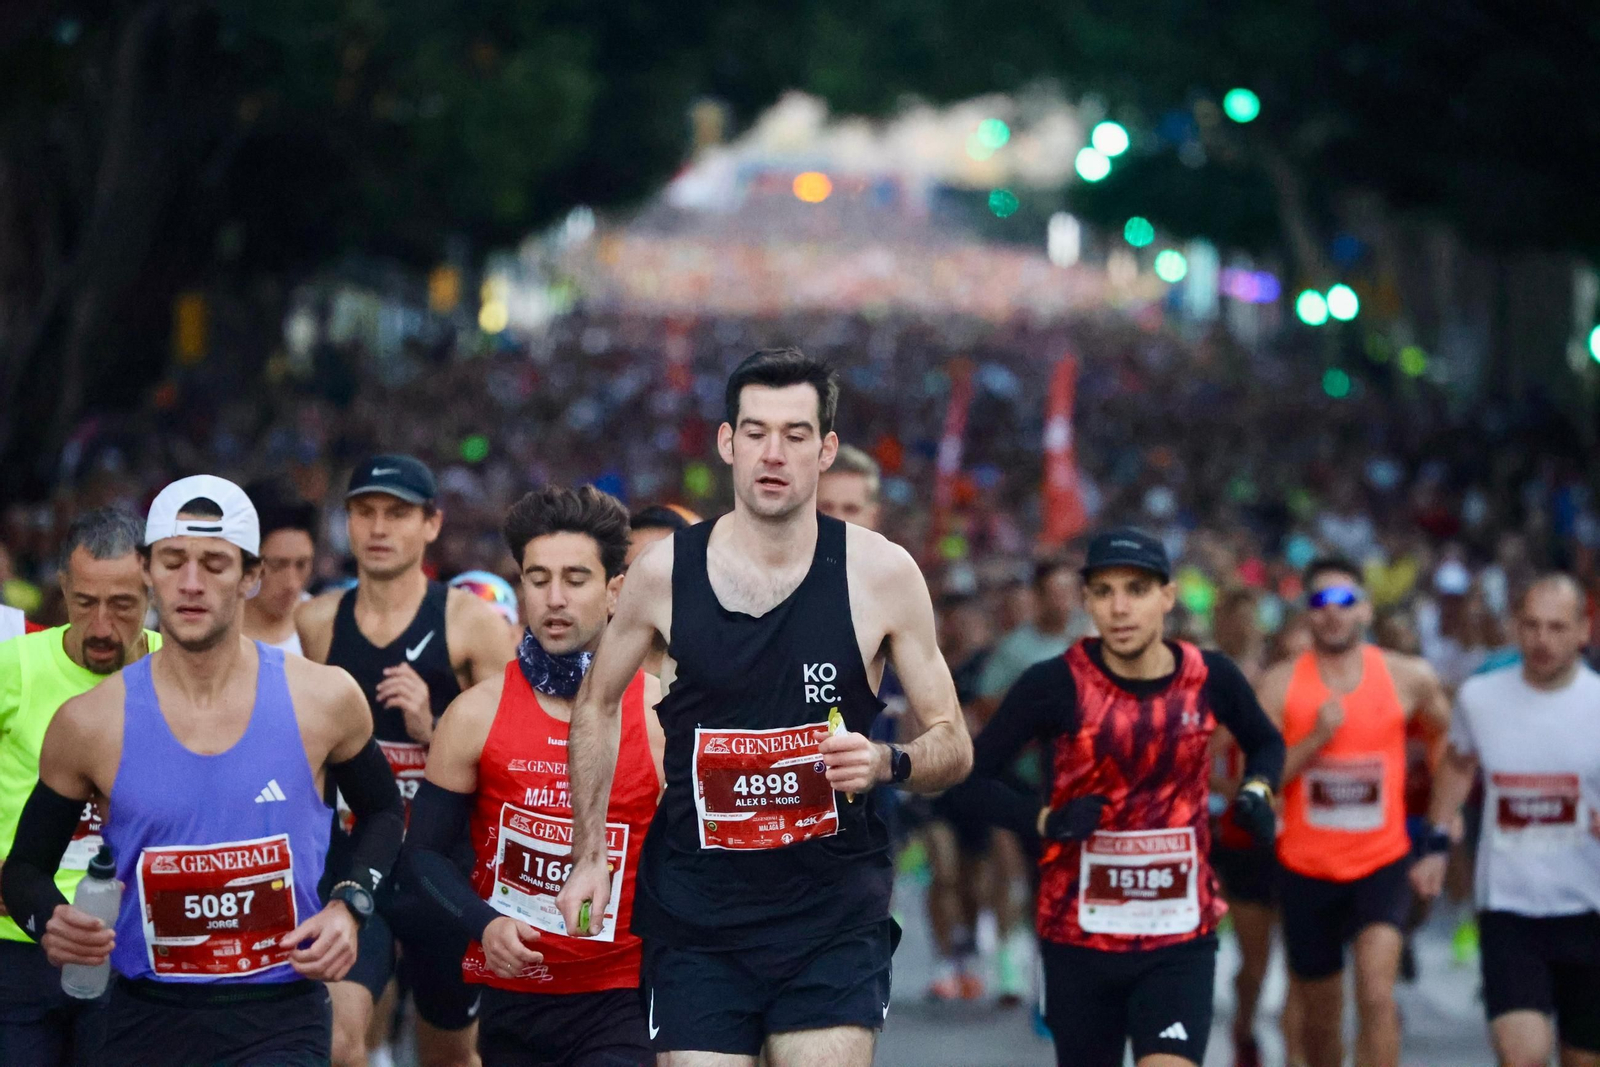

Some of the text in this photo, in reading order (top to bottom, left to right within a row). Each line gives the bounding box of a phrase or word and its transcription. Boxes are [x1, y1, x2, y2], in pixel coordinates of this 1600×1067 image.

[803, 662, 837, 682] KO
[805, 684, 842, 703] RC.
[733, 771, 799, 796] 4898
[735, 799, 758, 807] ALEX
[761, 798, 767, 806] B
[775, 796, 800, 805] KORC
[795, 816, 818, 828] 42K
[180, 845, 281, 873] GENERALI
[519, 873, 544, 888] JOHAN
[1107, 867, 1175, 889] 15186
[184, 890, 256, 919] 5087
[206, 919, 239, 929] JORGE
